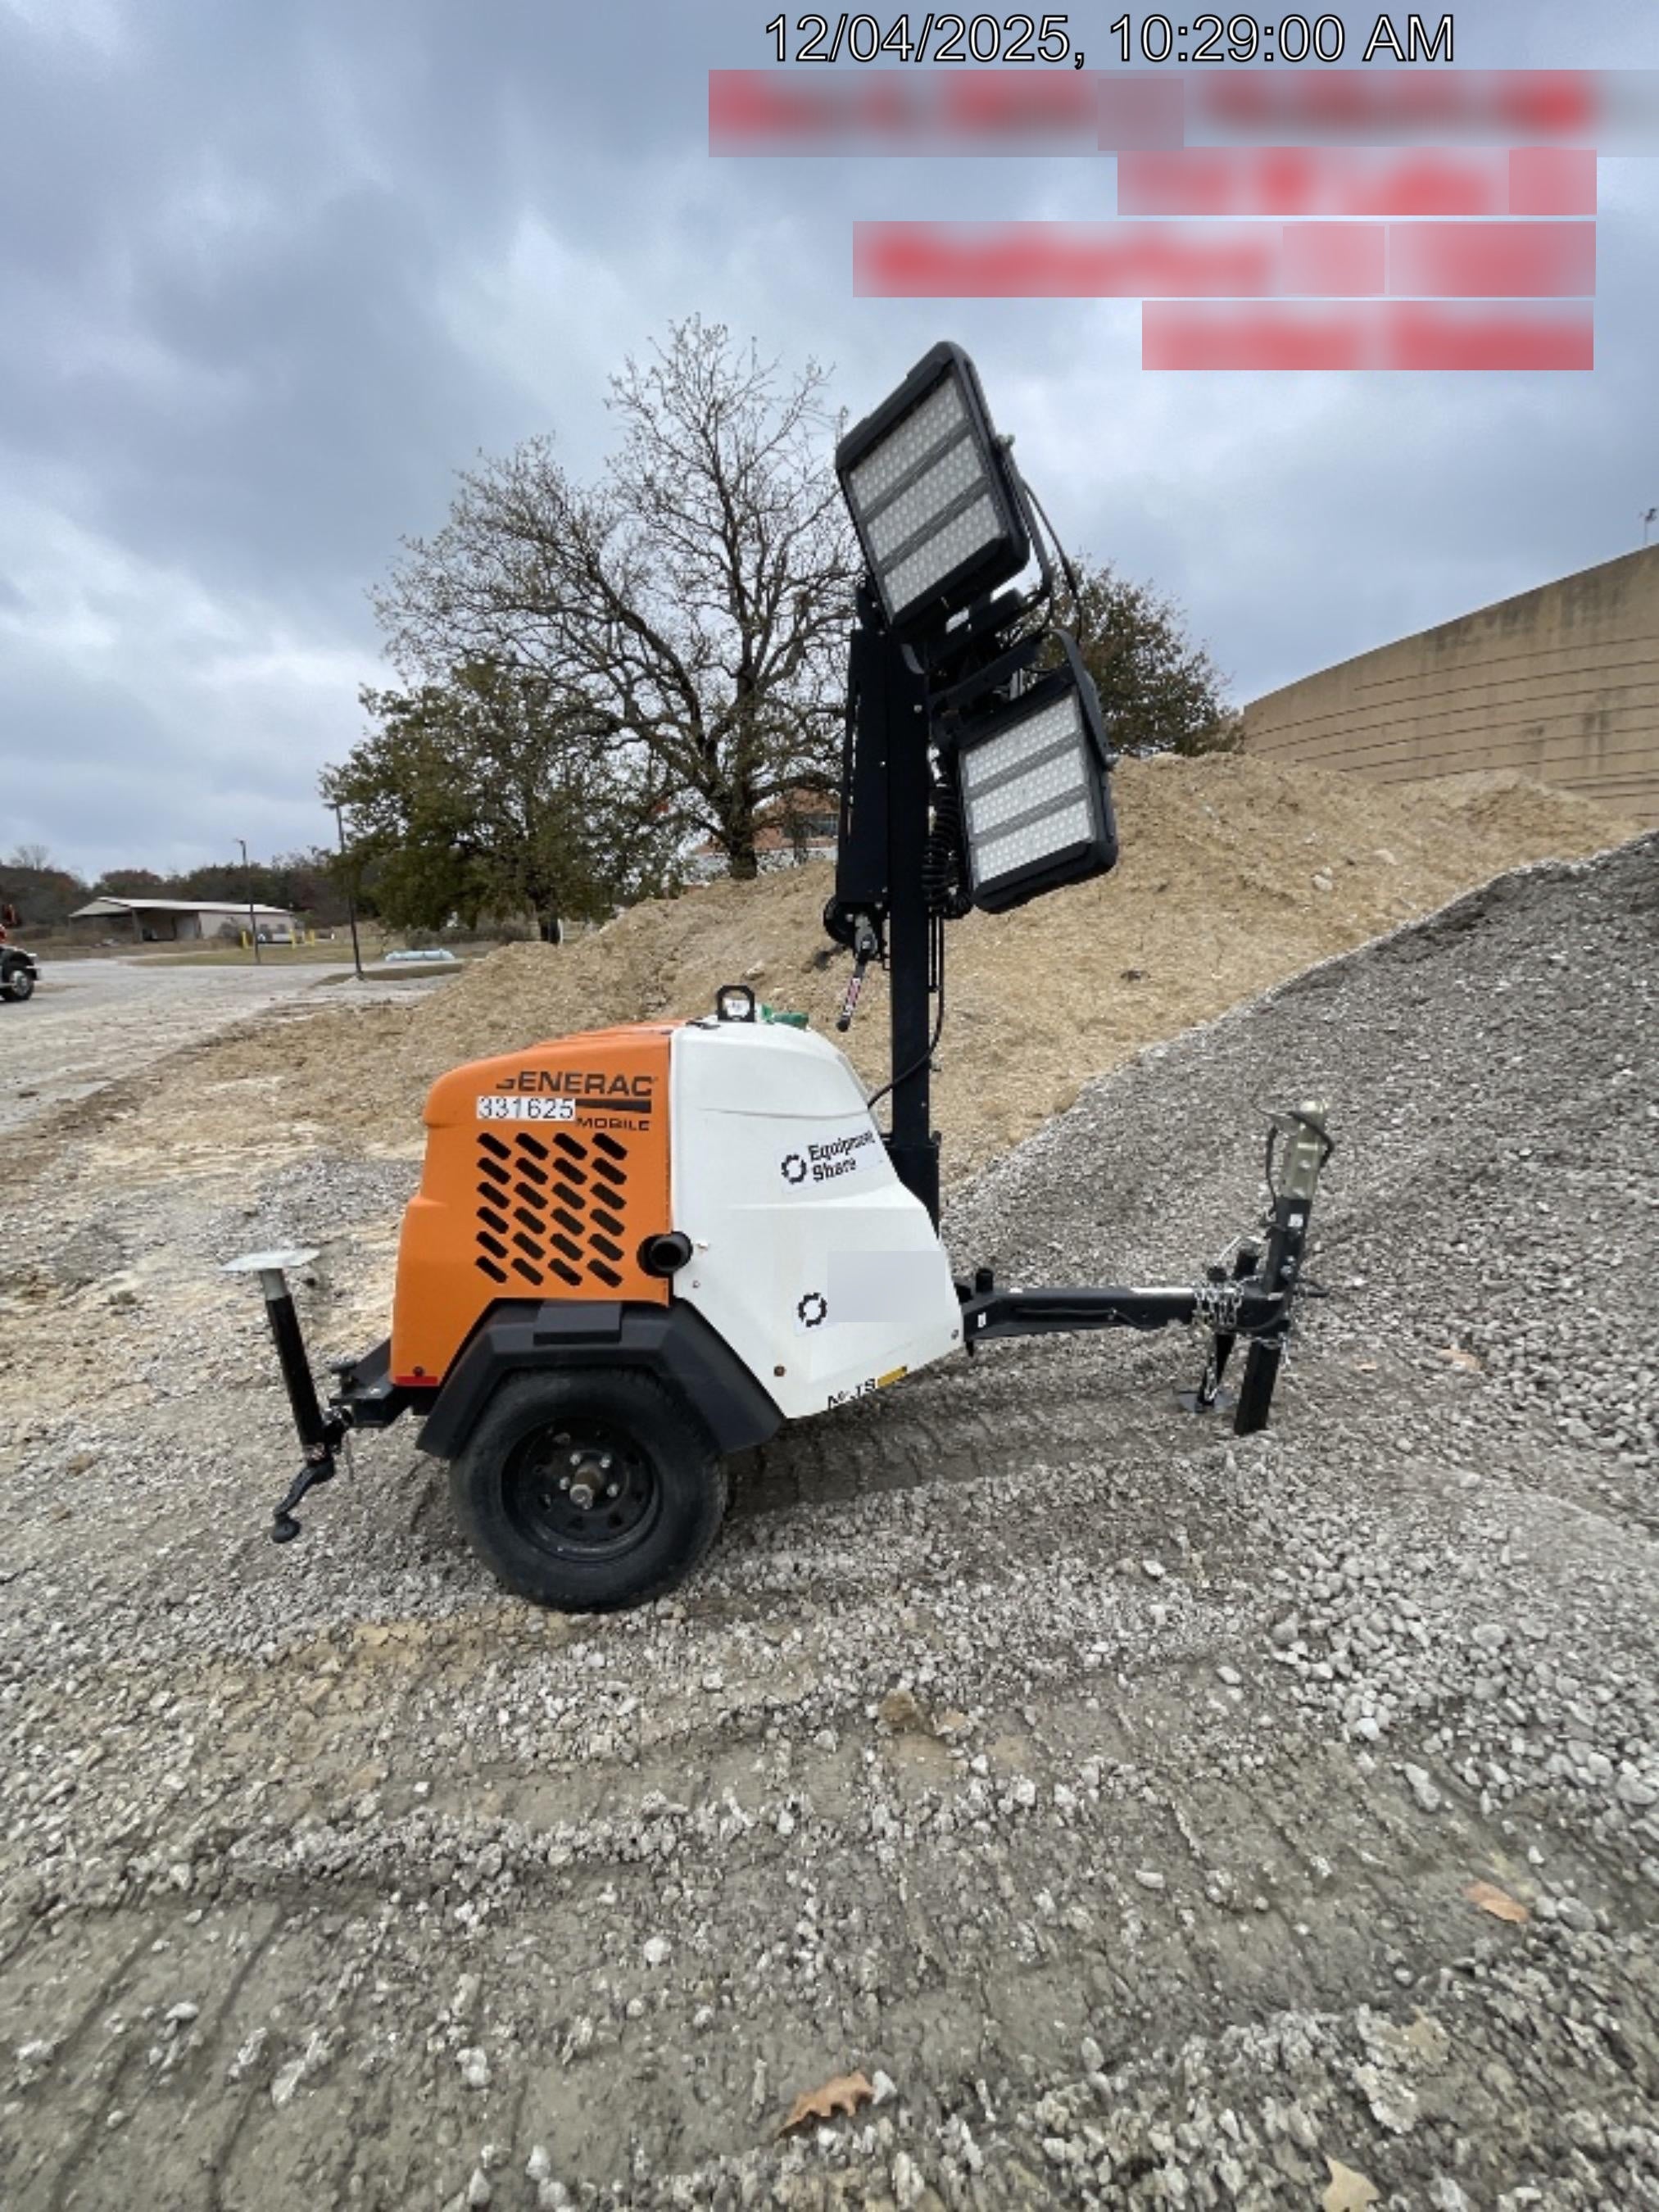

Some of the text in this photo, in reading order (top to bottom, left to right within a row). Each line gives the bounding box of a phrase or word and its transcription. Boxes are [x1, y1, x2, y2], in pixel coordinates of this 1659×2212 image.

[479, 1097, 573, 1119] 331625
[577, 1117, 650, 1131] MOBILE
[813, 1158, 856, 1182] Share
